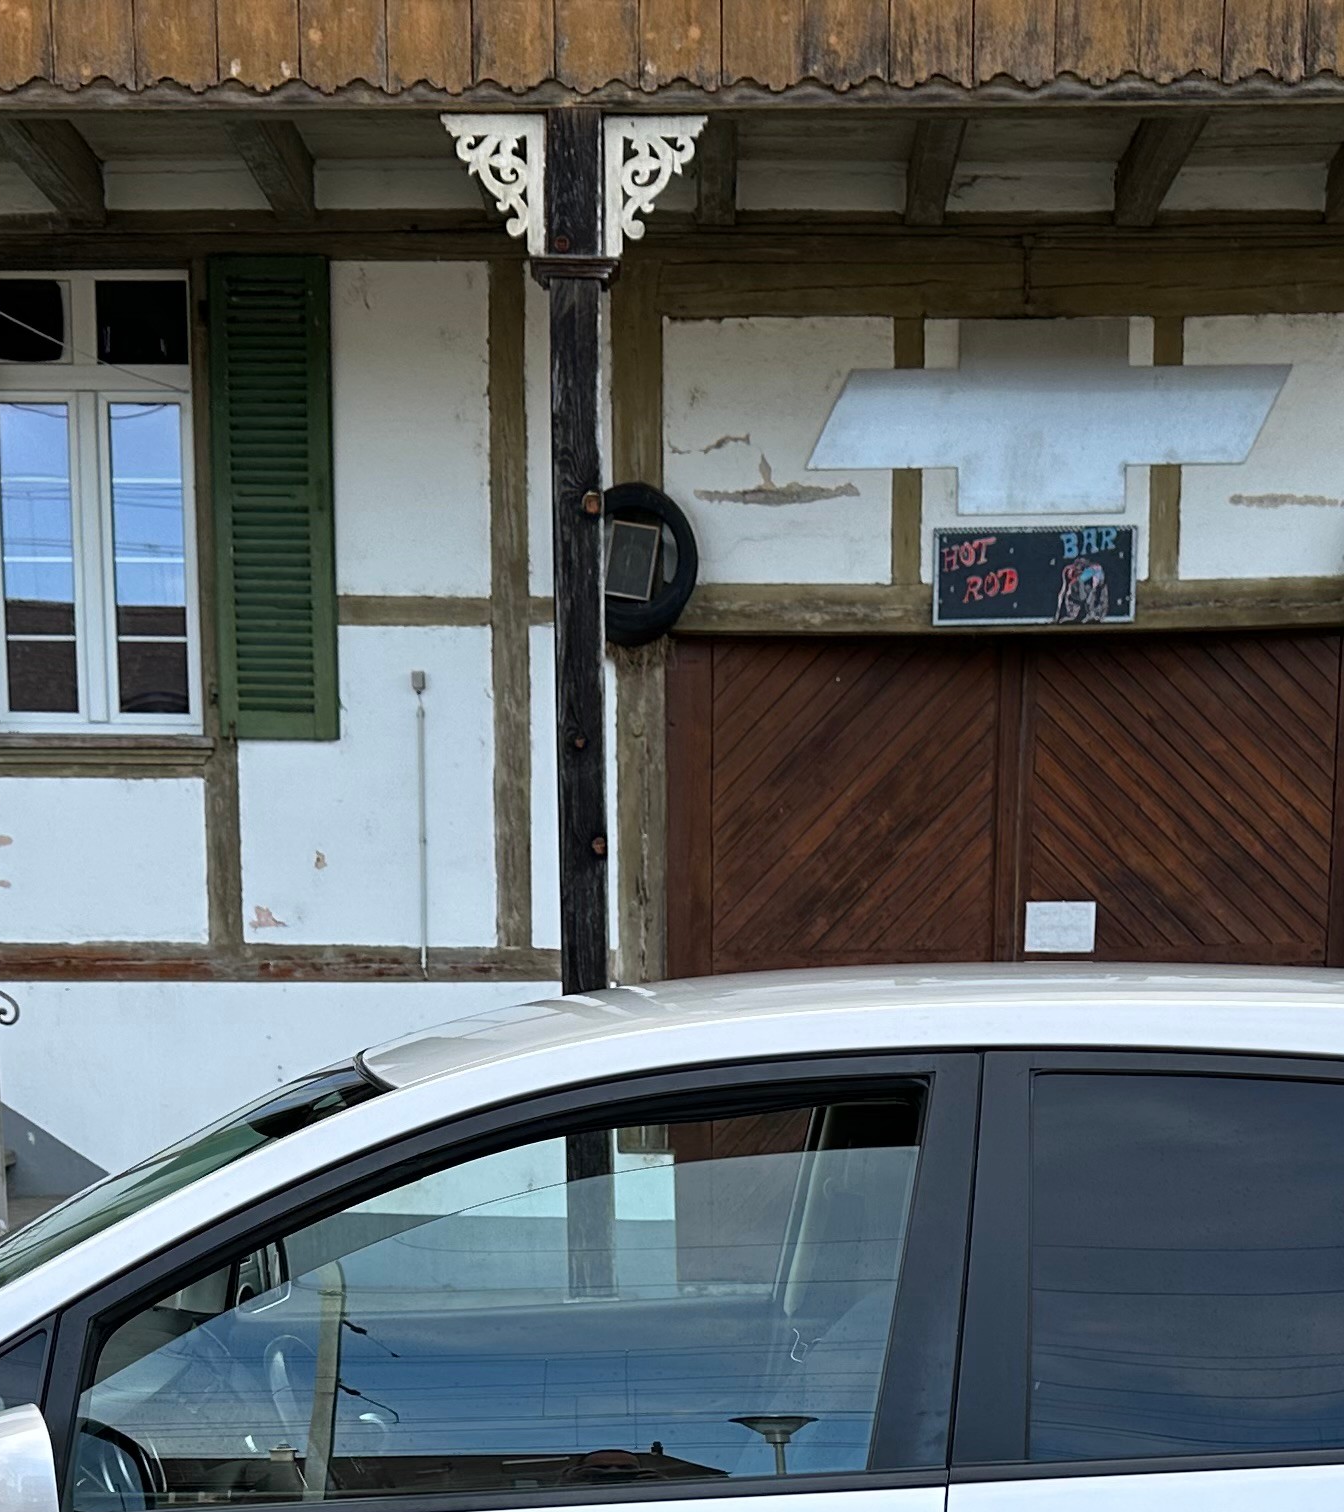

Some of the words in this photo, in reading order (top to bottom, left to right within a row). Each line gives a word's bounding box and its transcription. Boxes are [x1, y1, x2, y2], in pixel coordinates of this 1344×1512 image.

[941, 537, 997, 572] HOT
[1060, 527, 1119, 559] BAR
[962, 568, 1018, 603] ROD
